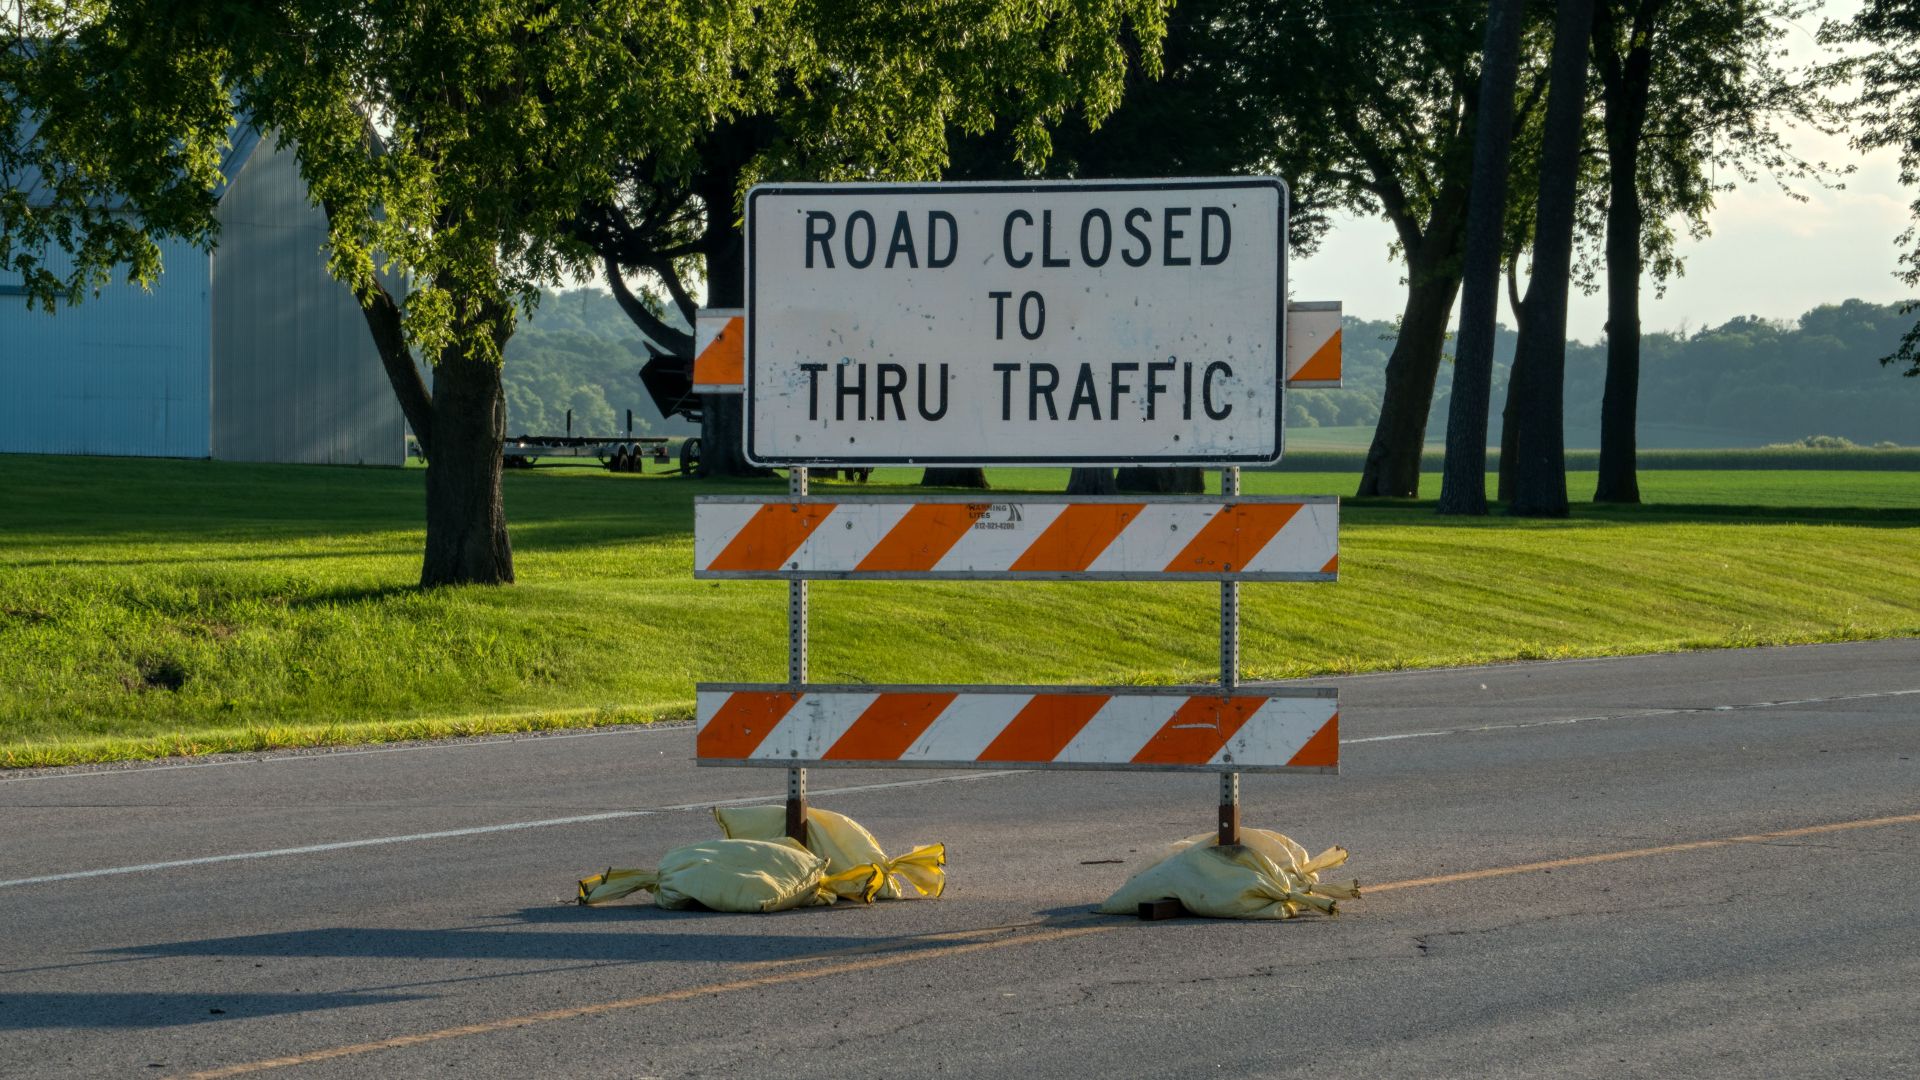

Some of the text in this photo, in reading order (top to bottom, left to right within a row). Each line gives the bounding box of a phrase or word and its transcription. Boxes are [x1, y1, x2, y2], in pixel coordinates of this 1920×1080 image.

[805, 206, 1232, 270] ROAD CLOSED
[988, 290, 1046, 341] TO
[799, 360, 1234, 422] THRU TRAFFIC
